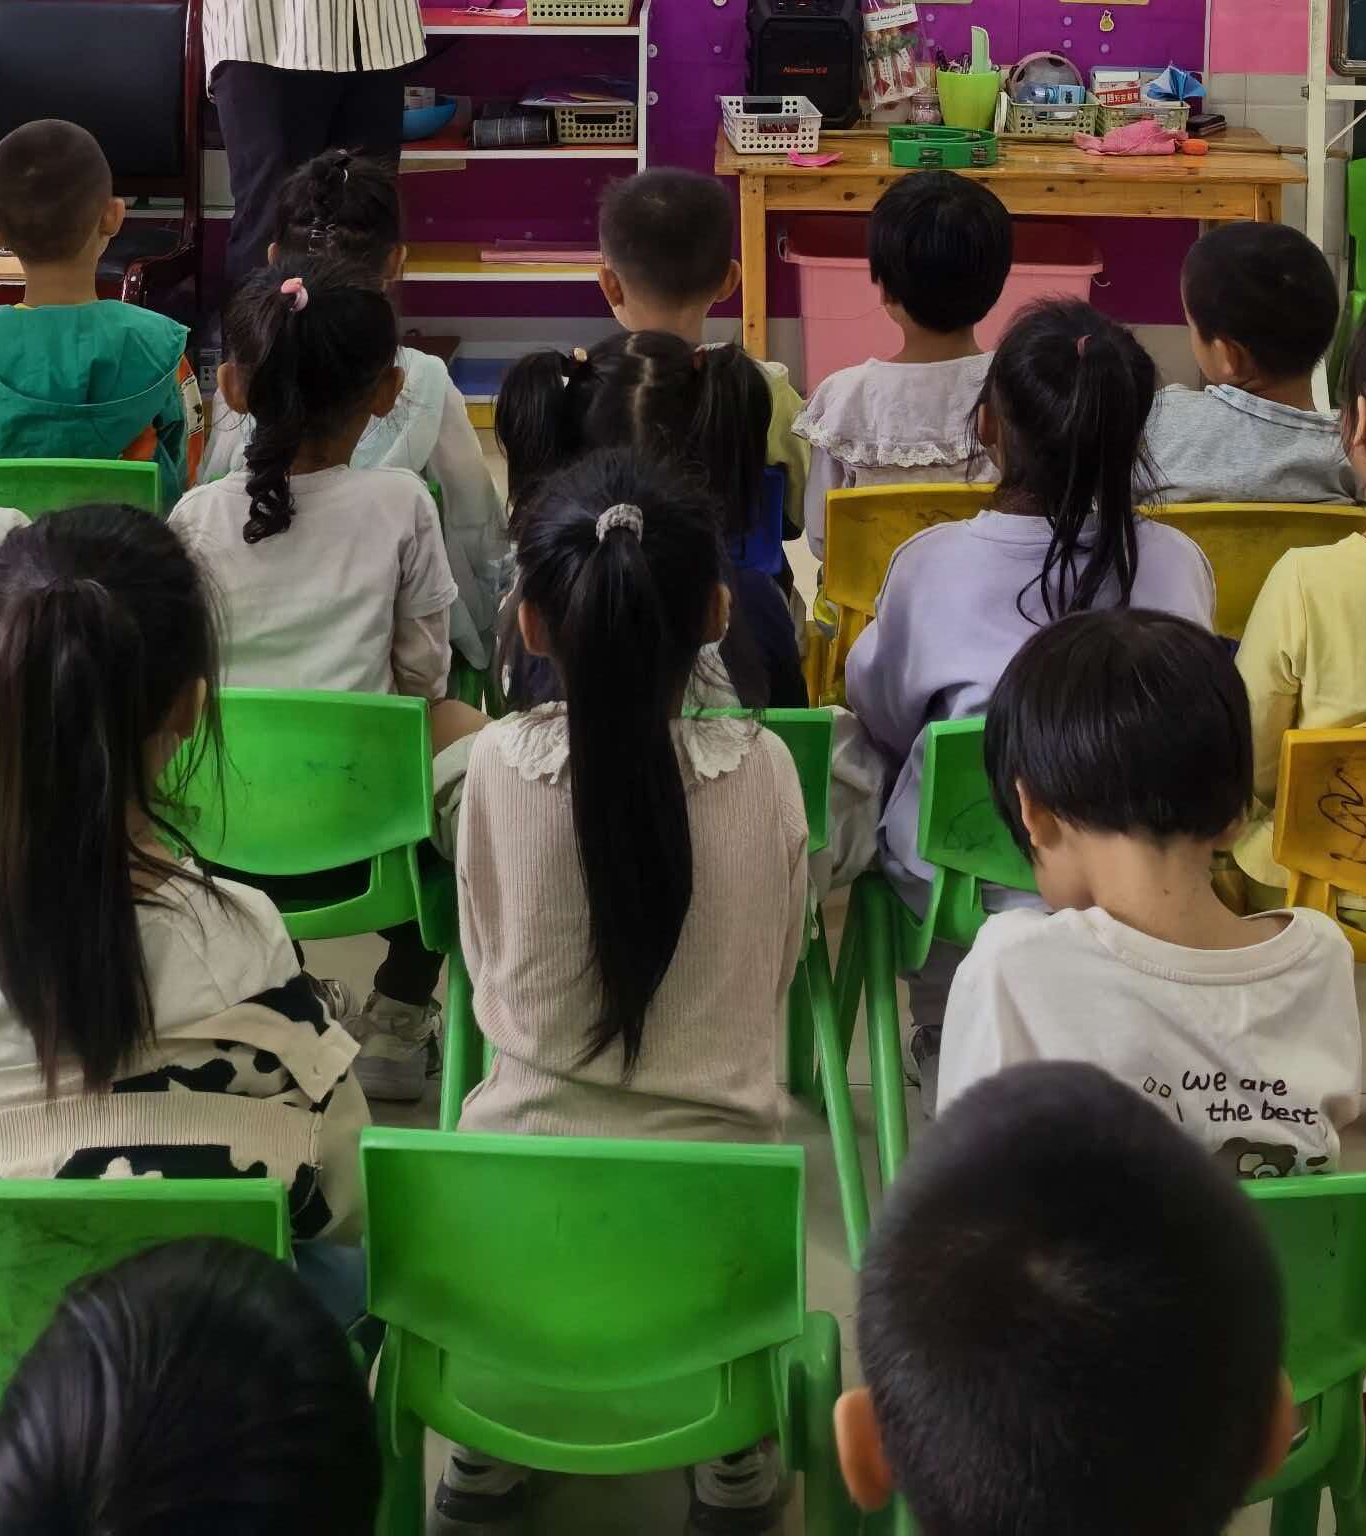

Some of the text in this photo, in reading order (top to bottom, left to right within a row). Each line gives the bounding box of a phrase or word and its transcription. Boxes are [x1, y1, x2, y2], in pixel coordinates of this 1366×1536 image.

[1239, 1078, 1288, 1096] are
[1206, 1098, 1319, 1125] the best
